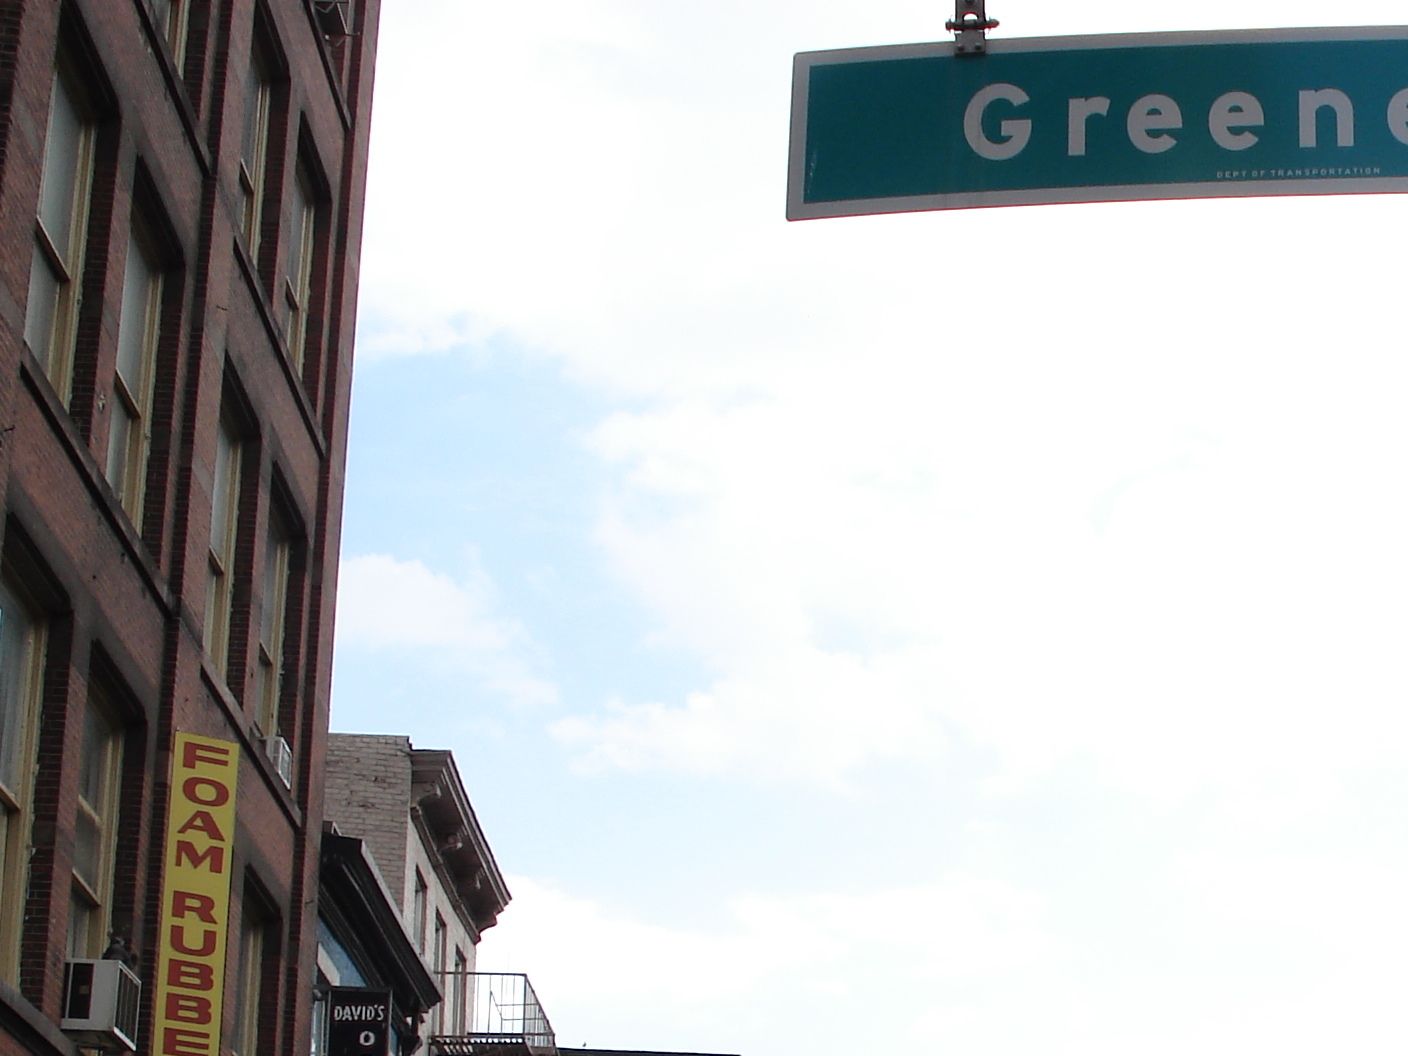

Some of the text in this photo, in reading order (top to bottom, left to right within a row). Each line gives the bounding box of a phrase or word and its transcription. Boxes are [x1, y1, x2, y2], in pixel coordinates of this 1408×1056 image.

[1216, 167, 1381, 179] DEPT OF TRANSPORTATION
[175, 740, 230, 874] FOAM
[333, 1004, 385, 1021] DAVID'S
